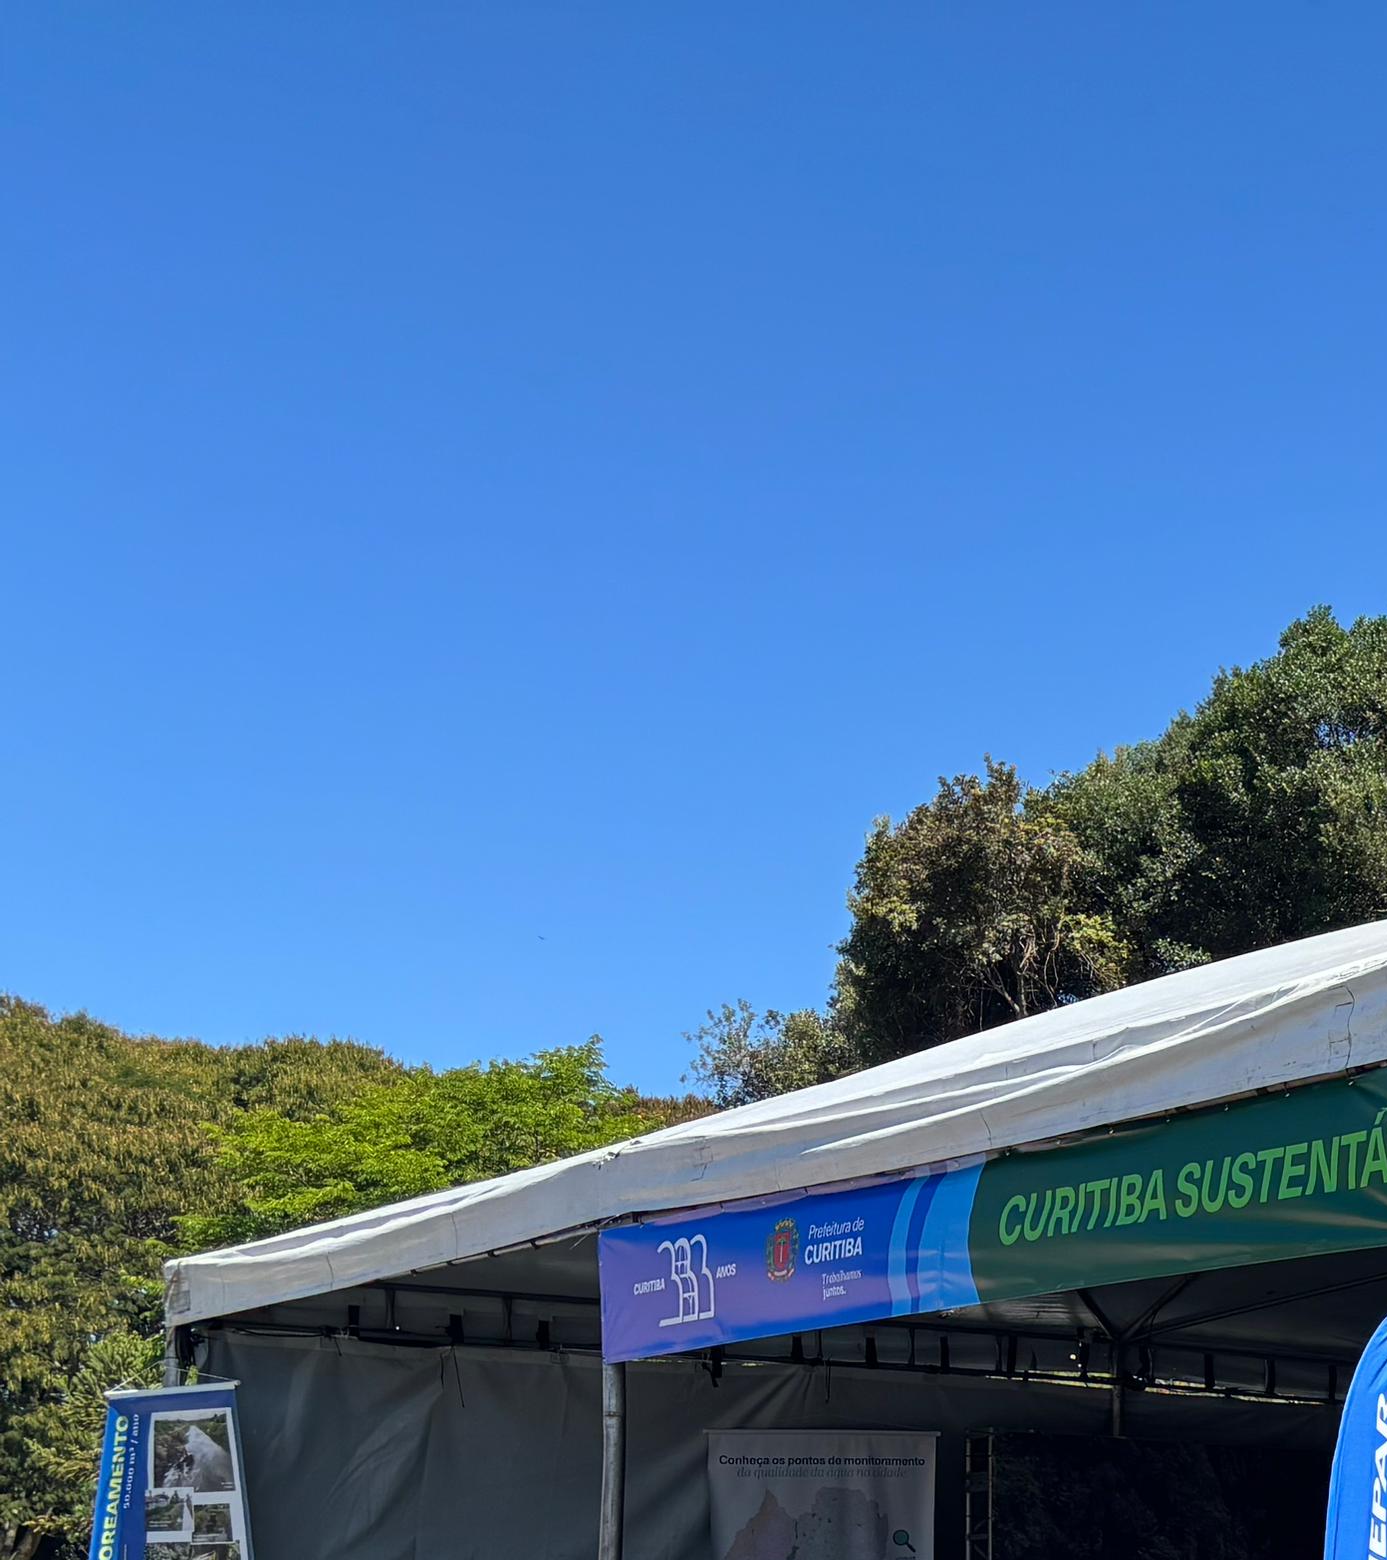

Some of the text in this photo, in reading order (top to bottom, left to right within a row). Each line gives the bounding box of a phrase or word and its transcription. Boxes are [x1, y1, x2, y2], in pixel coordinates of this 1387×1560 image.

[998, 1167, 1169, 1248] CURITIBA
[808, 1216, 865, 1240] Prefeitura de
[804, 1236, 863, 1265] CURITIBA
[633, 1278, 665, 1296] CURITIBA
[715, 1263, 737, 1279] ANOS
[821, 1269, 862, 1286] Trabalhamos
[822, 1286, 847, 1300] juntos.
[719, 1455, 926, 1468] Conheça os pontos de monitoramento
